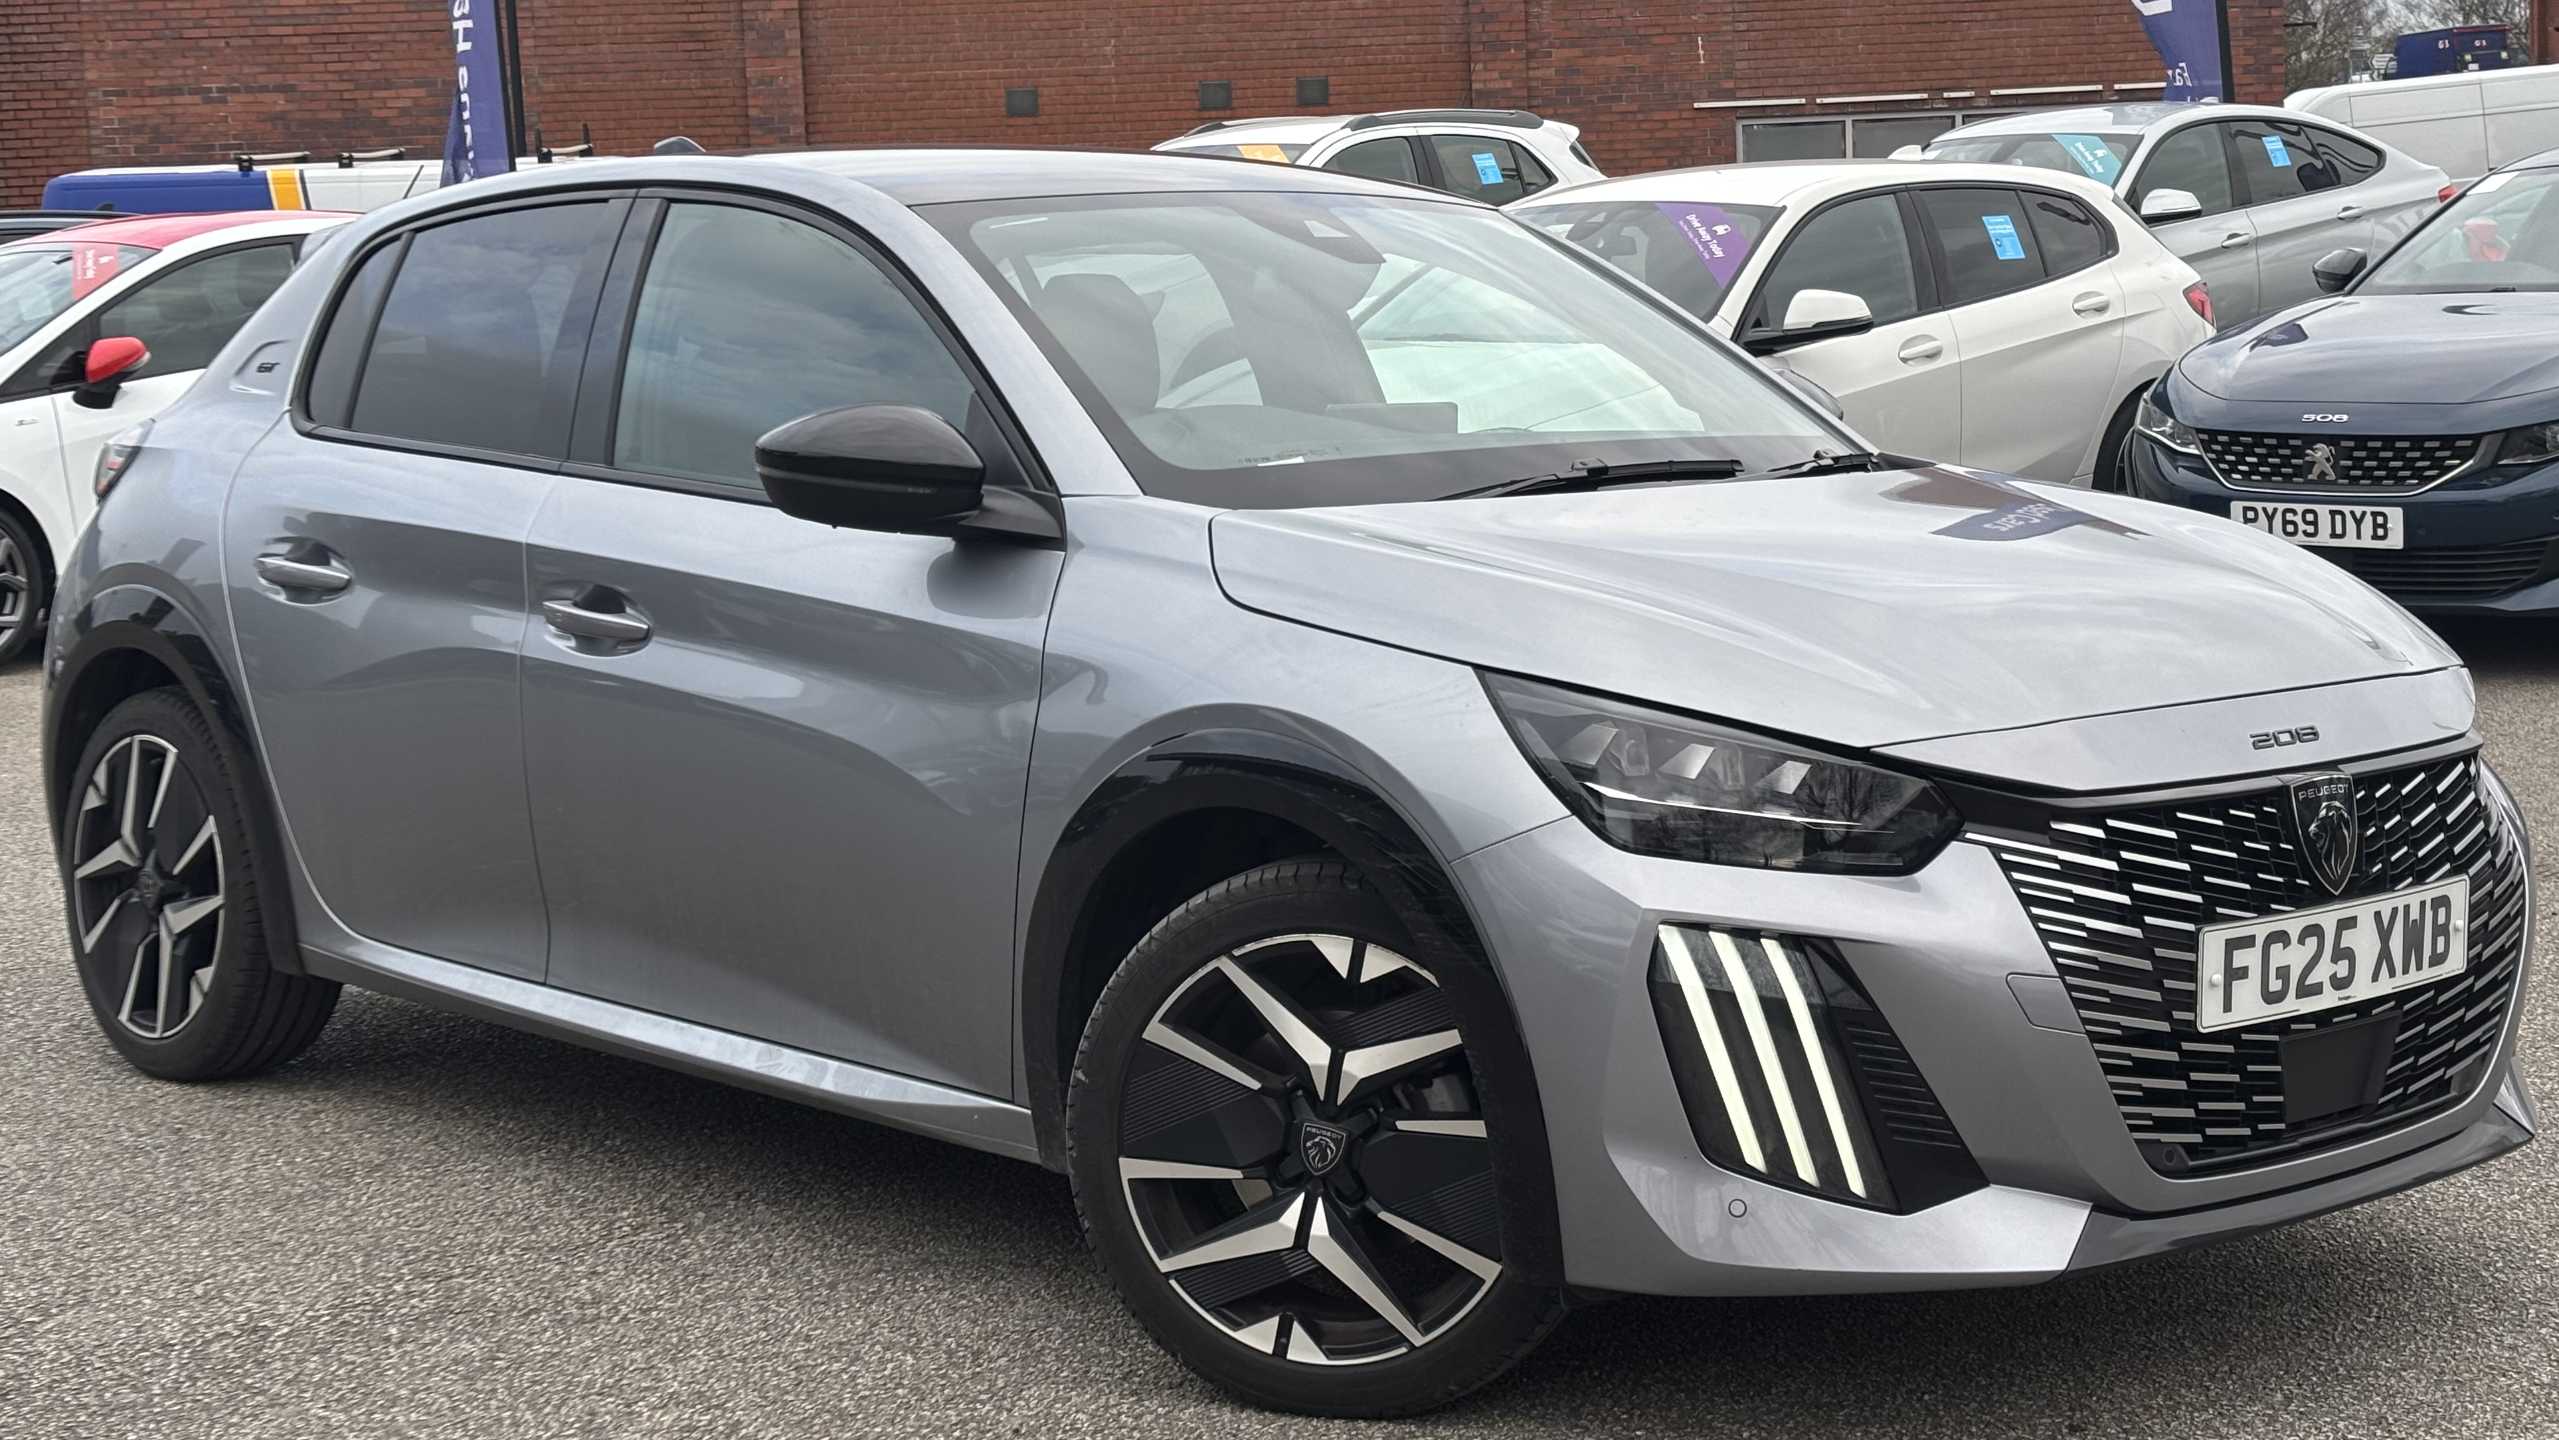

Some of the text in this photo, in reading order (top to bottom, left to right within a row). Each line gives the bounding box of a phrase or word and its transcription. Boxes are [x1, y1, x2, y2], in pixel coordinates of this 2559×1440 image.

[2301, 413, 2349, 423] 508
[2242, 505, 2389, 541] PY69 DYB
[2249, 725, 2320, 750] 208
[2298, 783, 2349, 801] PEUGEOT
[2222, 894, 2453, 1014] FG25 XWB
